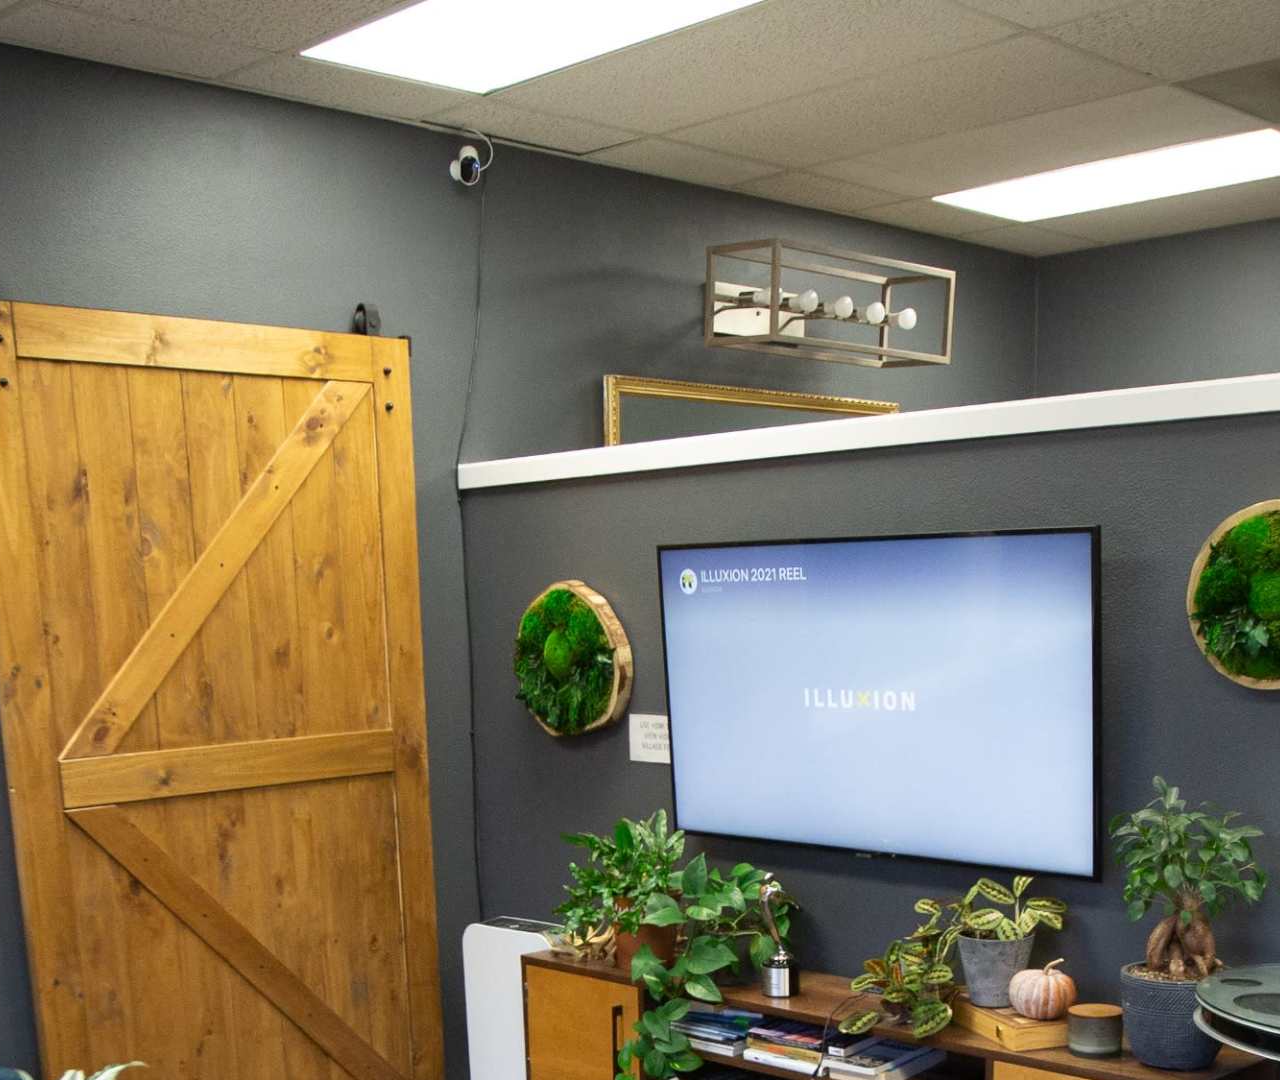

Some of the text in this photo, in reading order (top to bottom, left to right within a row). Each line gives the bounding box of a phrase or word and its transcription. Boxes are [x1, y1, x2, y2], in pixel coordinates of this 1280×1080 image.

[701, 567, 807, 582] ILLUXION 2021 REEL
[804, 688, 916, 711] ILLUXION
